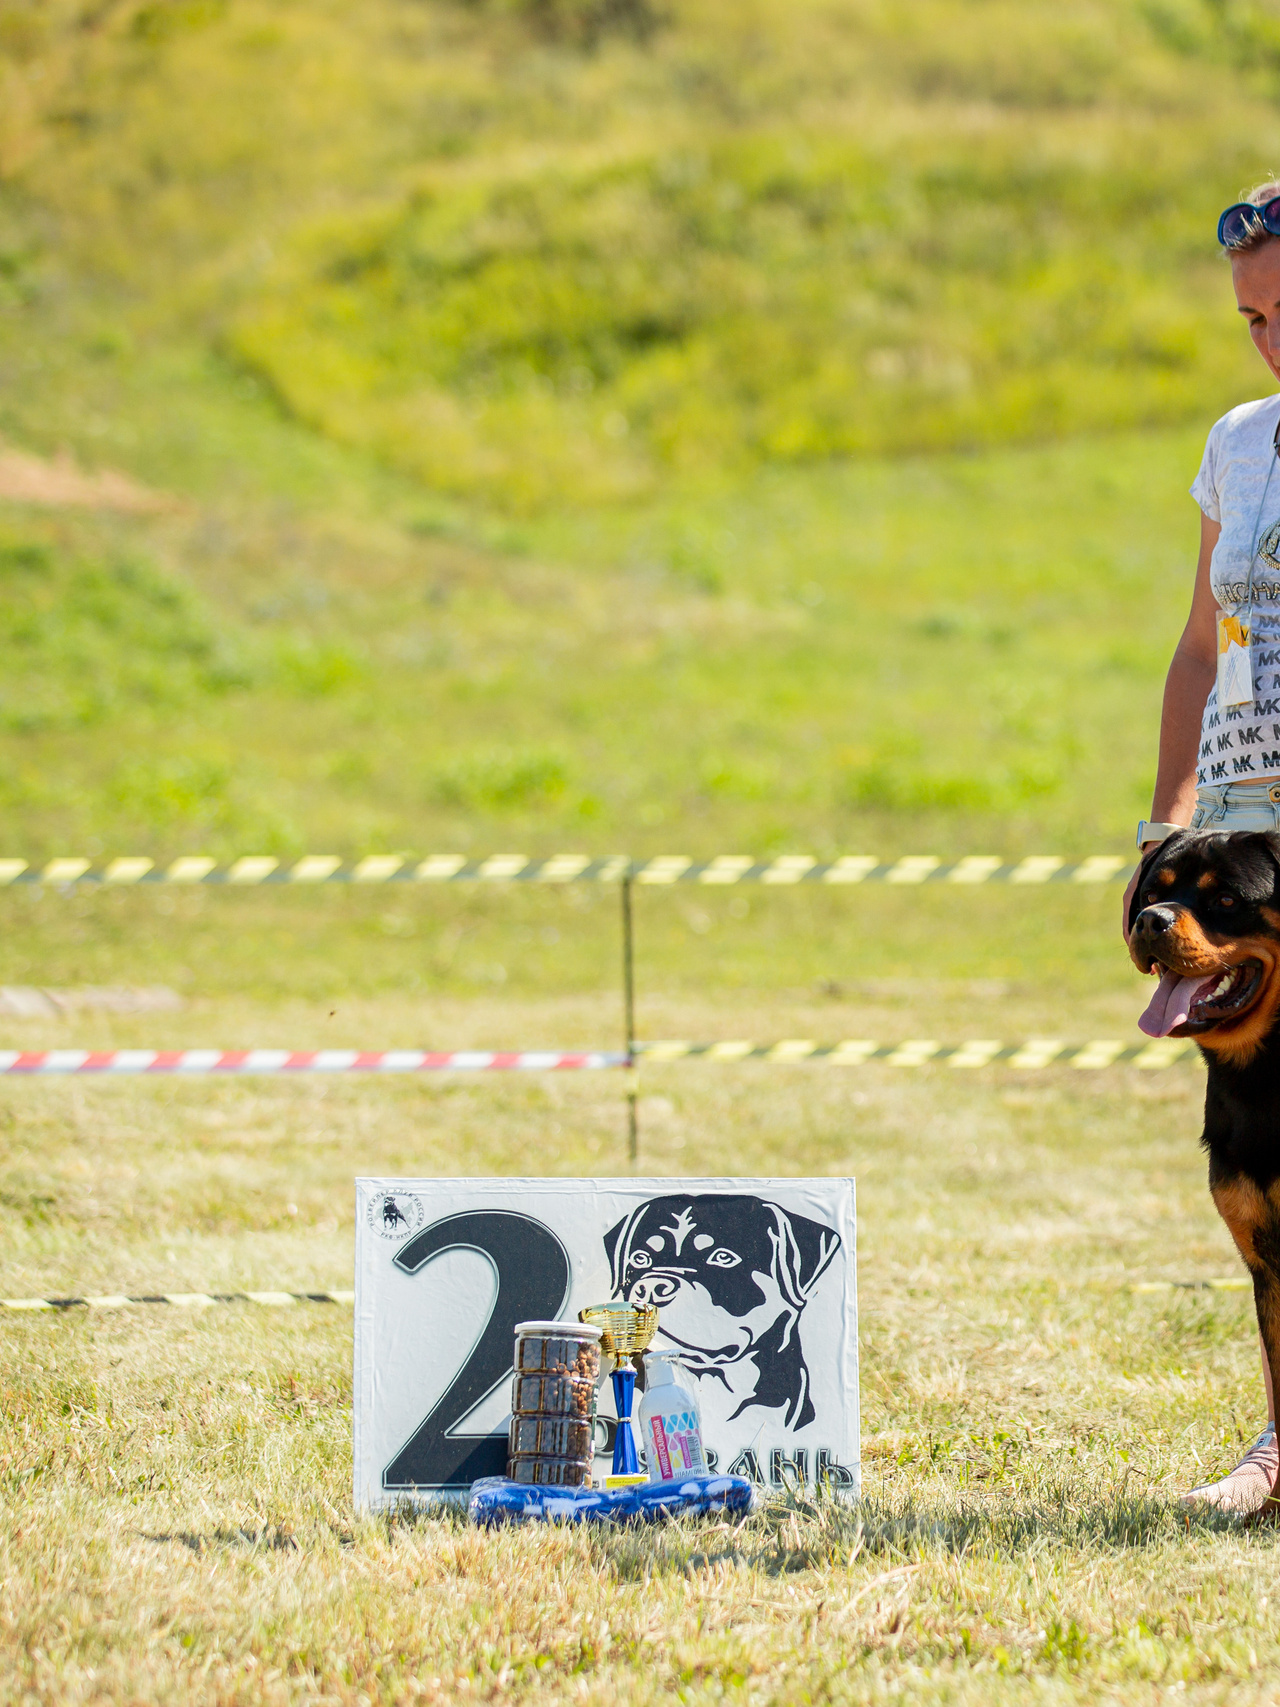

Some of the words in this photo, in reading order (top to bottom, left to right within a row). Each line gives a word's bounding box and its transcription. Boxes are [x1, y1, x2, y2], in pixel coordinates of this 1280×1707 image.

[1253, 697, 1280, 717] MK
[1216, 731, 1234, 752] MK
[1238, 725, 1264, 745] MK
[1210, 760, 1229, 780] MK
[1232, 754, 1256, 774] MK
[382, 1208, 572, 1489] 2
